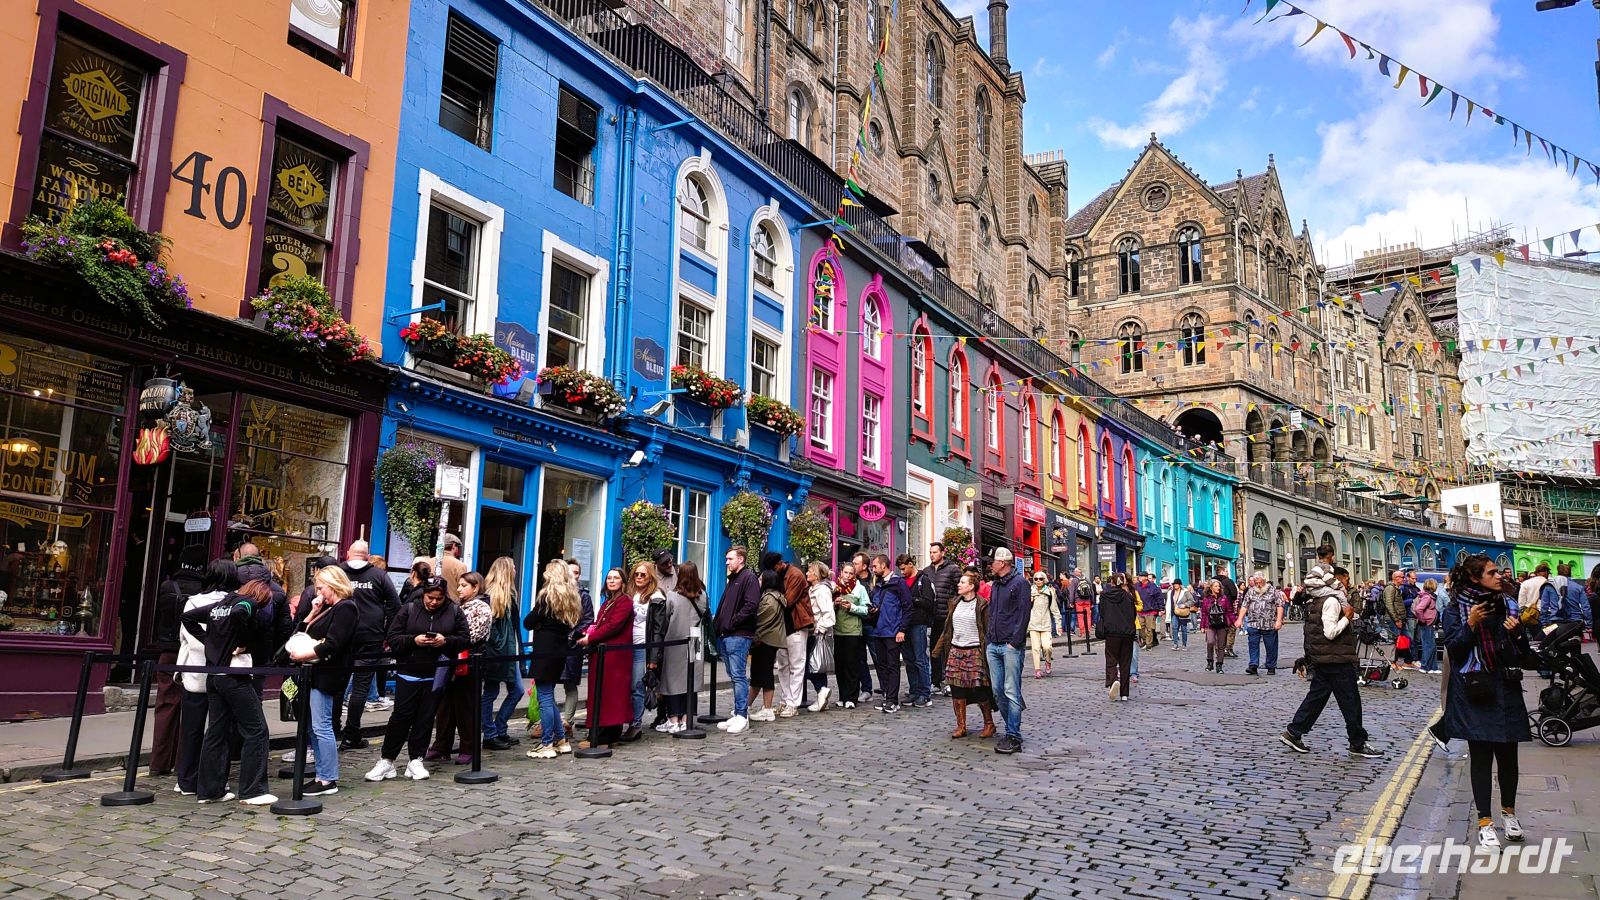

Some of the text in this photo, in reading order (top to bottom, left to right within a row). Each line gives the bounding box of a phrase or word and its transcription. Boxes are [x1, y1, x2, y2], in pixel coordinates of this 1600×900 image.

[72, 78, 122, 112] ORIGINAL
[50, 164, 113, 195] WORLD
[171, 151, 247, 230] 40
[288, 175, 317, 197] BEST
[51, 305, 65, 317] of
[72, 308, 135, 340] Officially
[138, 326, 190, 352] Licensed
[195, 343, 244, 366] HARRY
[244, 358, 295, 381] POTTER
[511, 347, 536, 364] BLEUE
[646, 361, 664, 376] BLEUE
[0, 438, 97, 485] USEUM
[2, 472, 73, 498] CONTEXT
